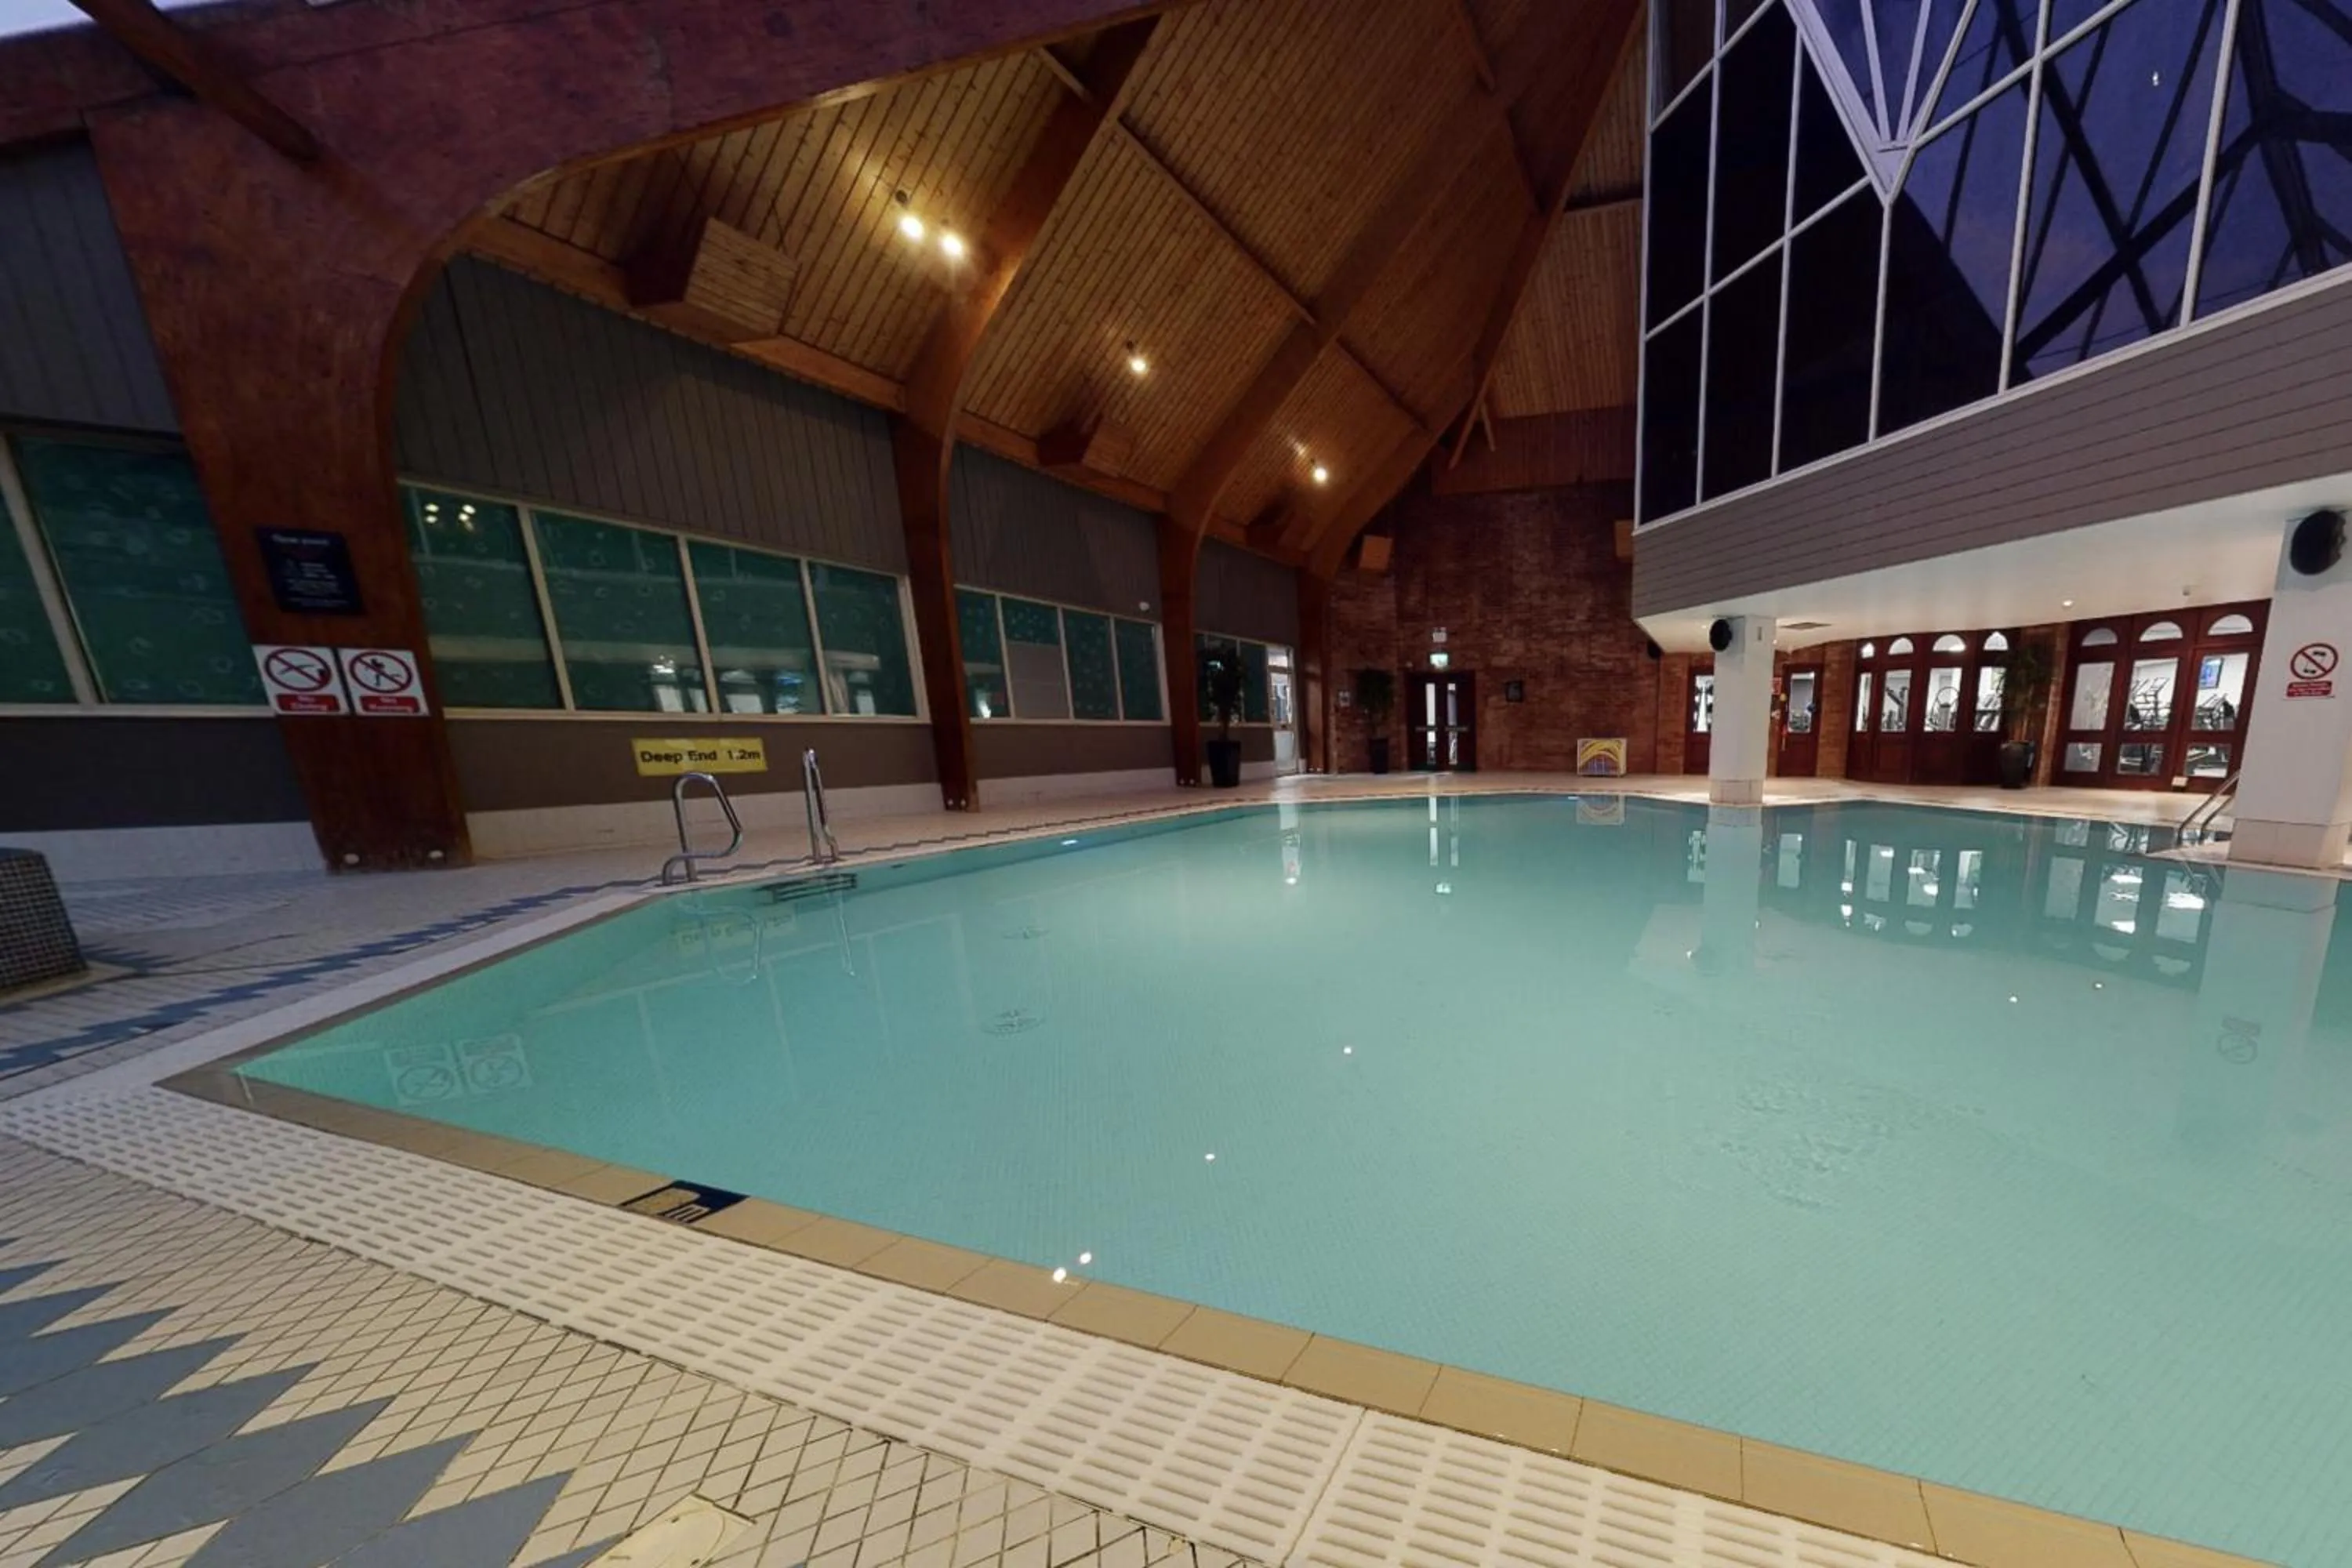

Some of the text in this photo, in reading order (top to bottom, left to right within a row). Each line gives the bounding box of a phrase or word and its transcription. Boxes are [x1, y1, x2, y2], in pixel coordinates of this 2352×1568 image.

[641, 749, 760, 764] Deep End 1.2m
